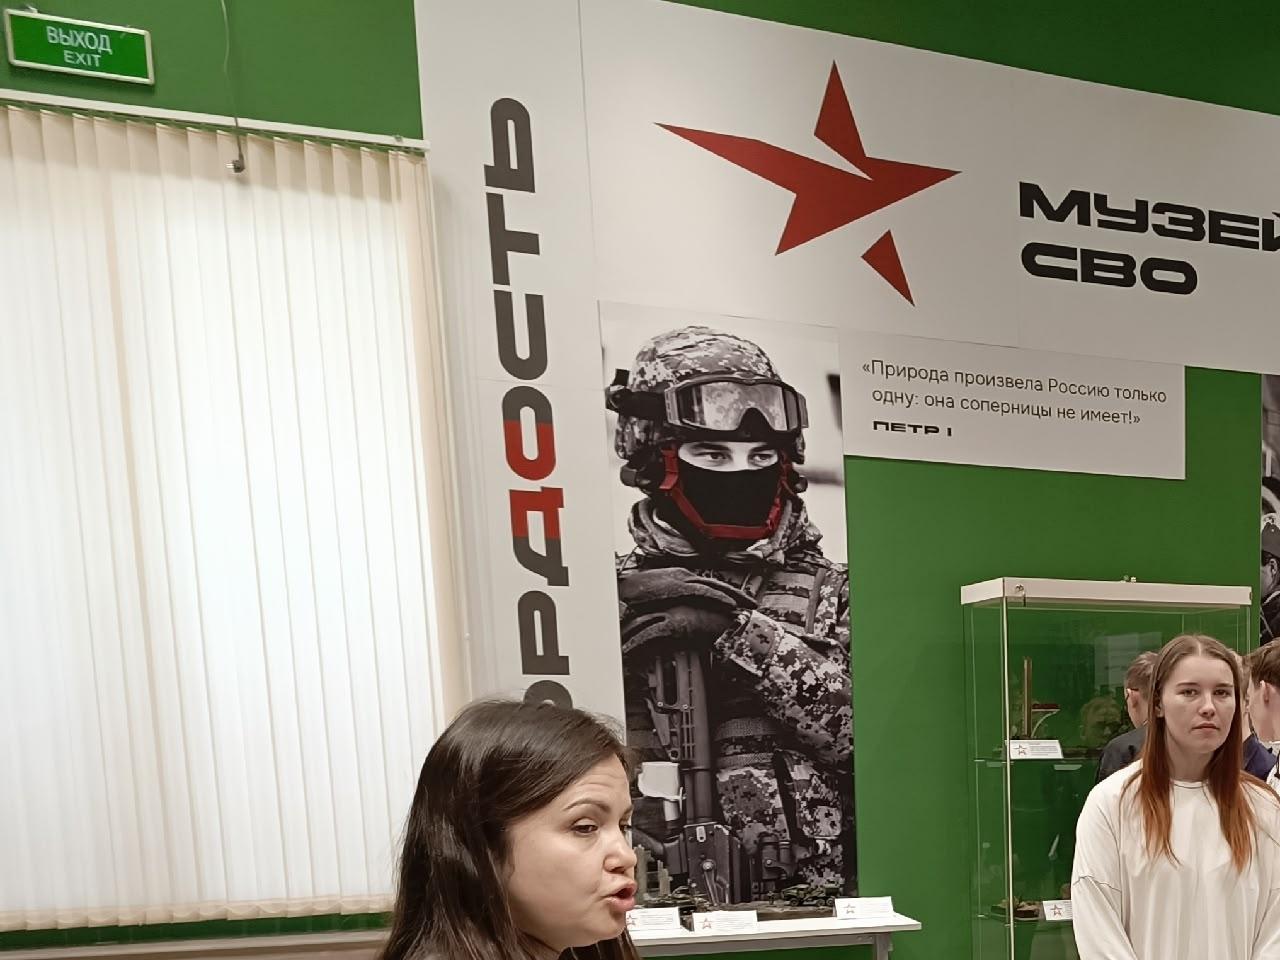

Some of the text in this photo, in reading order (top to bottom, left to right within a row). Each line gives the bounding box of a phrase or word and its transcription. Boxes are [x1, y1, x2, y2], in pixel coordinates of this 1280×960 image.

[46, 26, 112, 54] ВЫХОД
[64, 50, 101, 67] EXIT
[1021, 242, 1198, 295] СВО
[862, 359, 1167, 403] «Природа произвела Россию только
[484, 97, 573, 708] РДОСТЬ
[872, 388, 1141, 425] одну: она соперницы не имеет!»
[873, 420, 940, 435] ПЕТР
